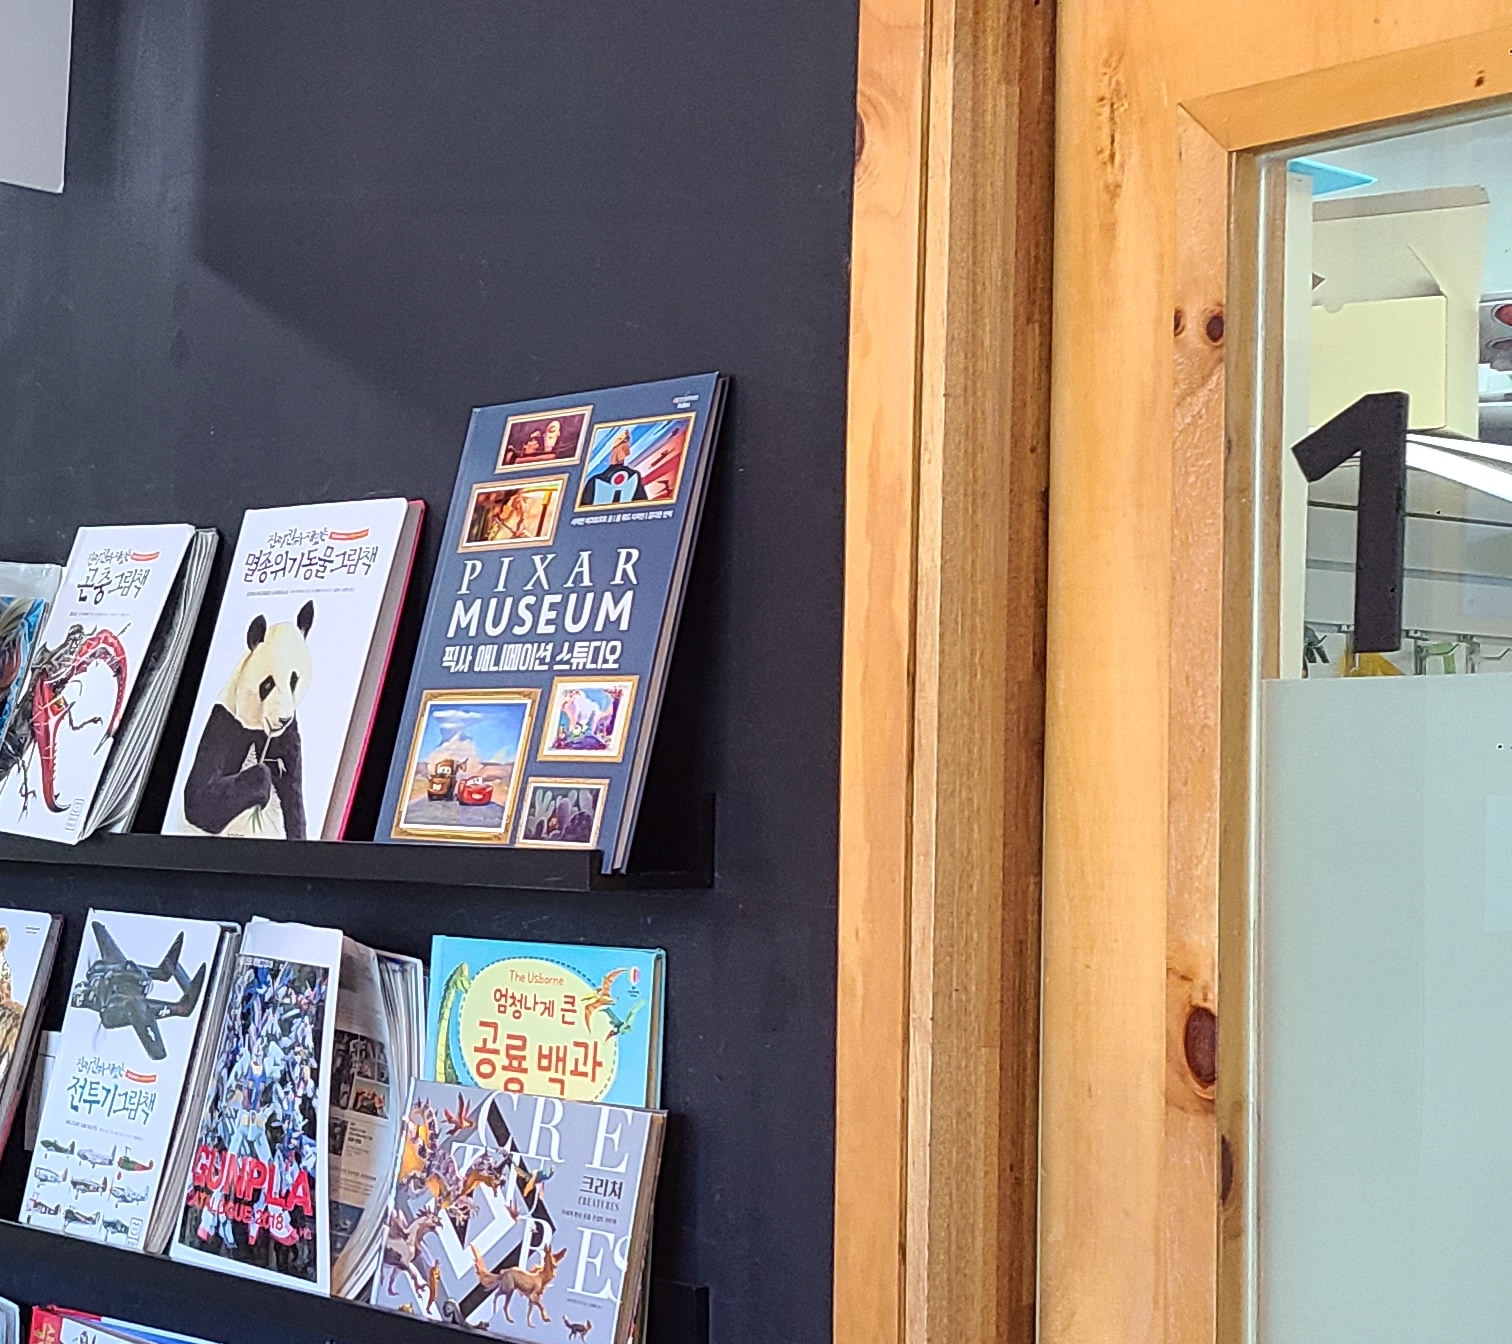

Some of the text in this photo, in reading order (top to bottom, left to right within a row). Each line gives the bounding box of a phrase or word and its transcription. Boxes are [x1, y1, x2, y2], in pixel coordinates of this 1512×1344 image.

[1292, 391, 1409, 653] 1
[457, 548, 640, 595] PIXAR
[446, 590, 634, 638] MUSEUM
[441, 640, 622, 673] 픽사 애니메이션 스튜디오
[509, 969, 565, 986] The Usborne
[493, 987, 578, 1026] 엄청나게 큰
[474, 1019, 604, 1096] 공룡 백과
[192, 1144, 314, 1216] GUNPLA
[579, 1174, 624, 1200] 크리처
[255, 1209, 285, 1231] 2018
